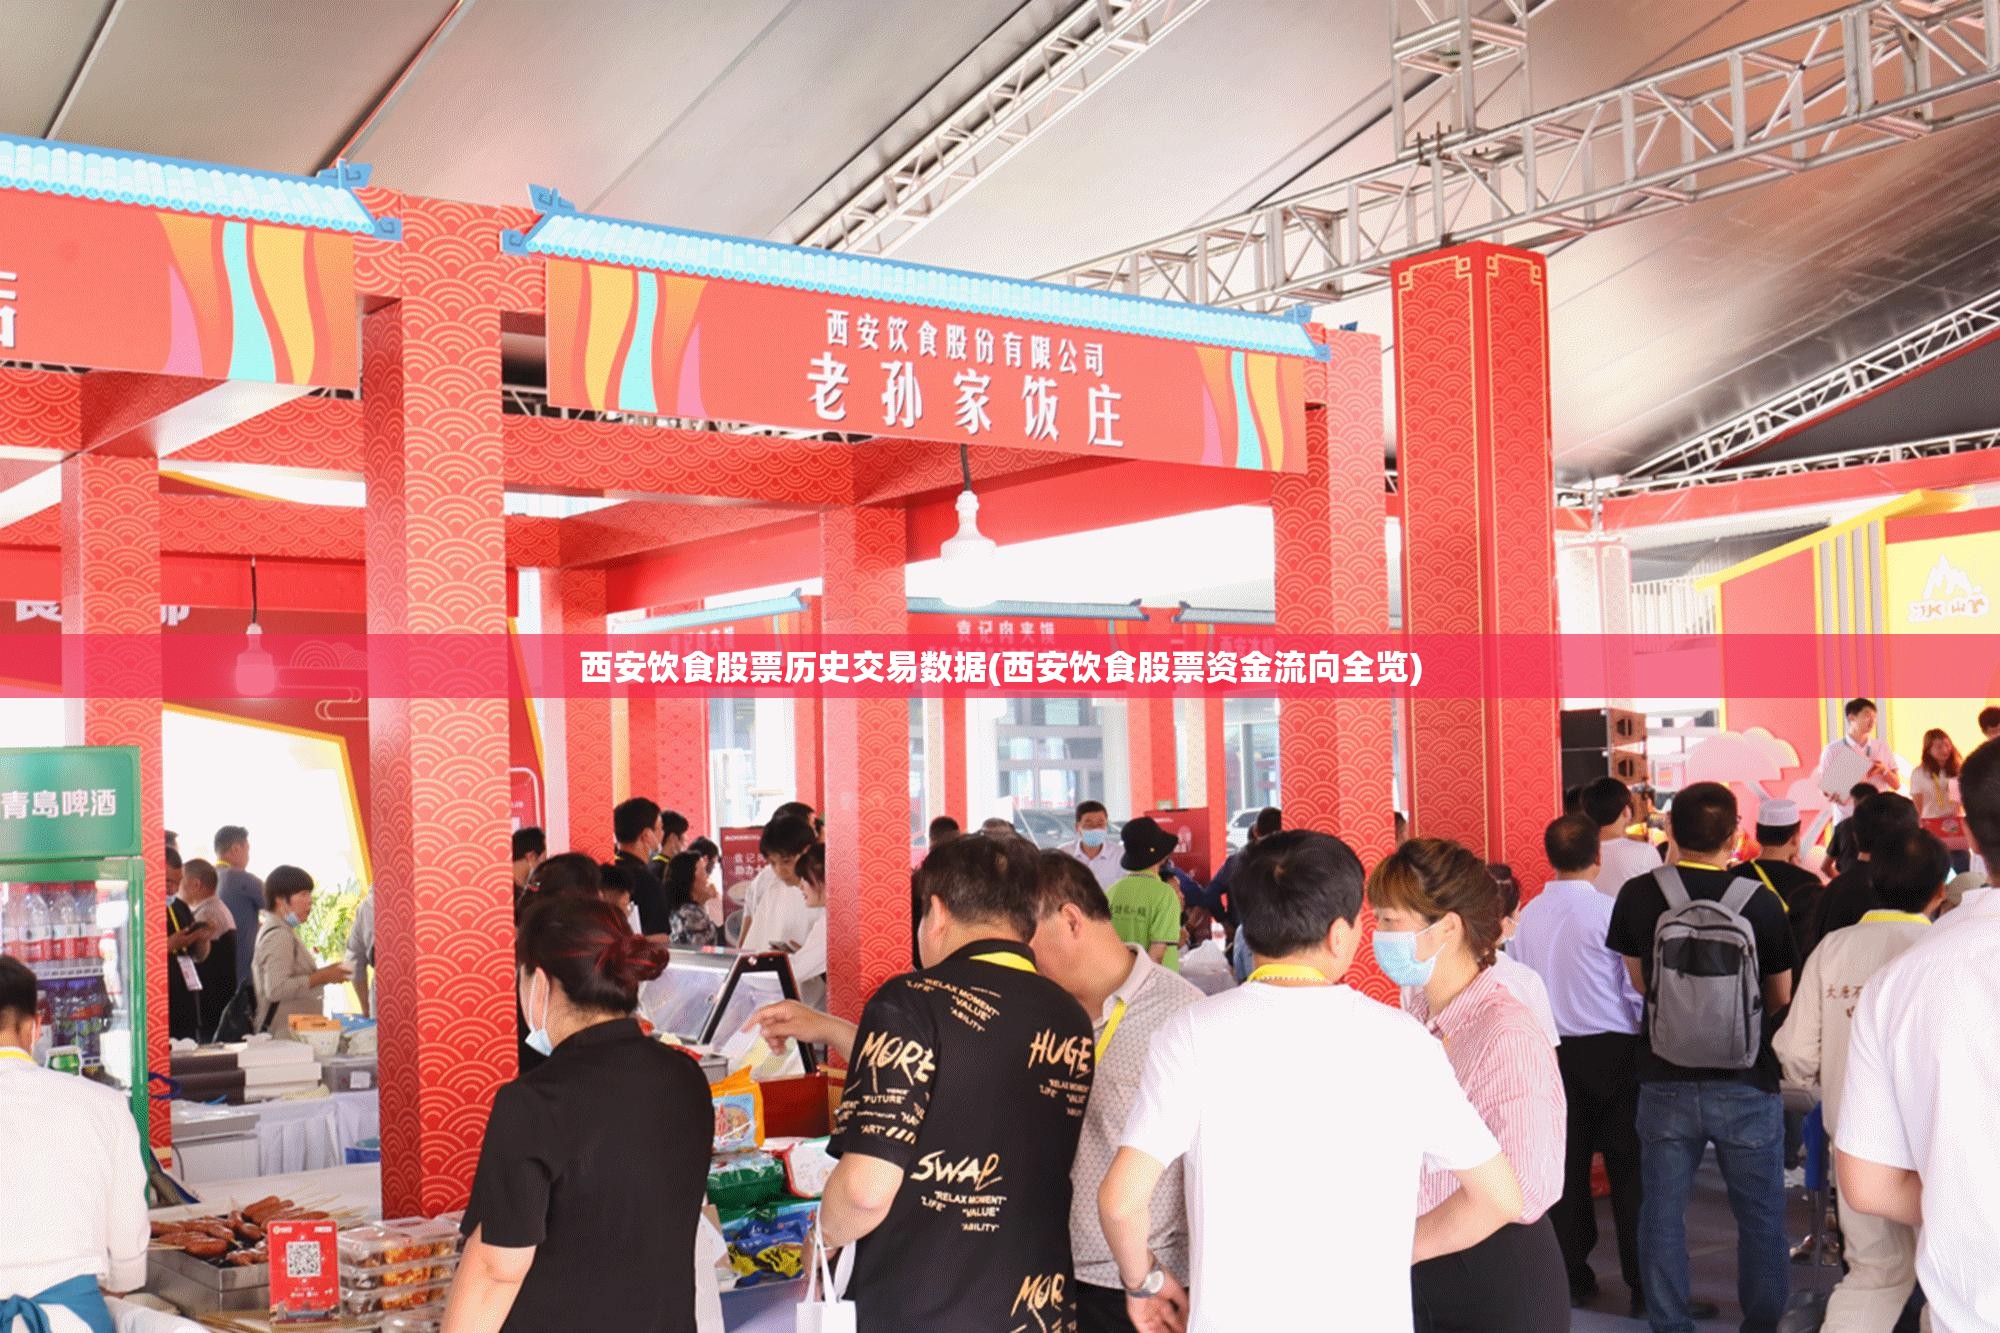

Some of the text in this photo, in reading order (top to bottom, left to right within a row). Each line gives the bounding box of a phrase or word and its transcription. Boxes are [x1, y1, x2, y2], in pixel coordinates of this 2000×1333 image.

[825, 308, 1105, 378] 西安饮食股份有限公司
[806, 351, 1125, 449] 老孙家饭庄
[855, 1031, 936, 1086] MORE
[1028, 1028, 1093, 1078] HUGE
[910, 1149, 1003, 1192] SWAP
